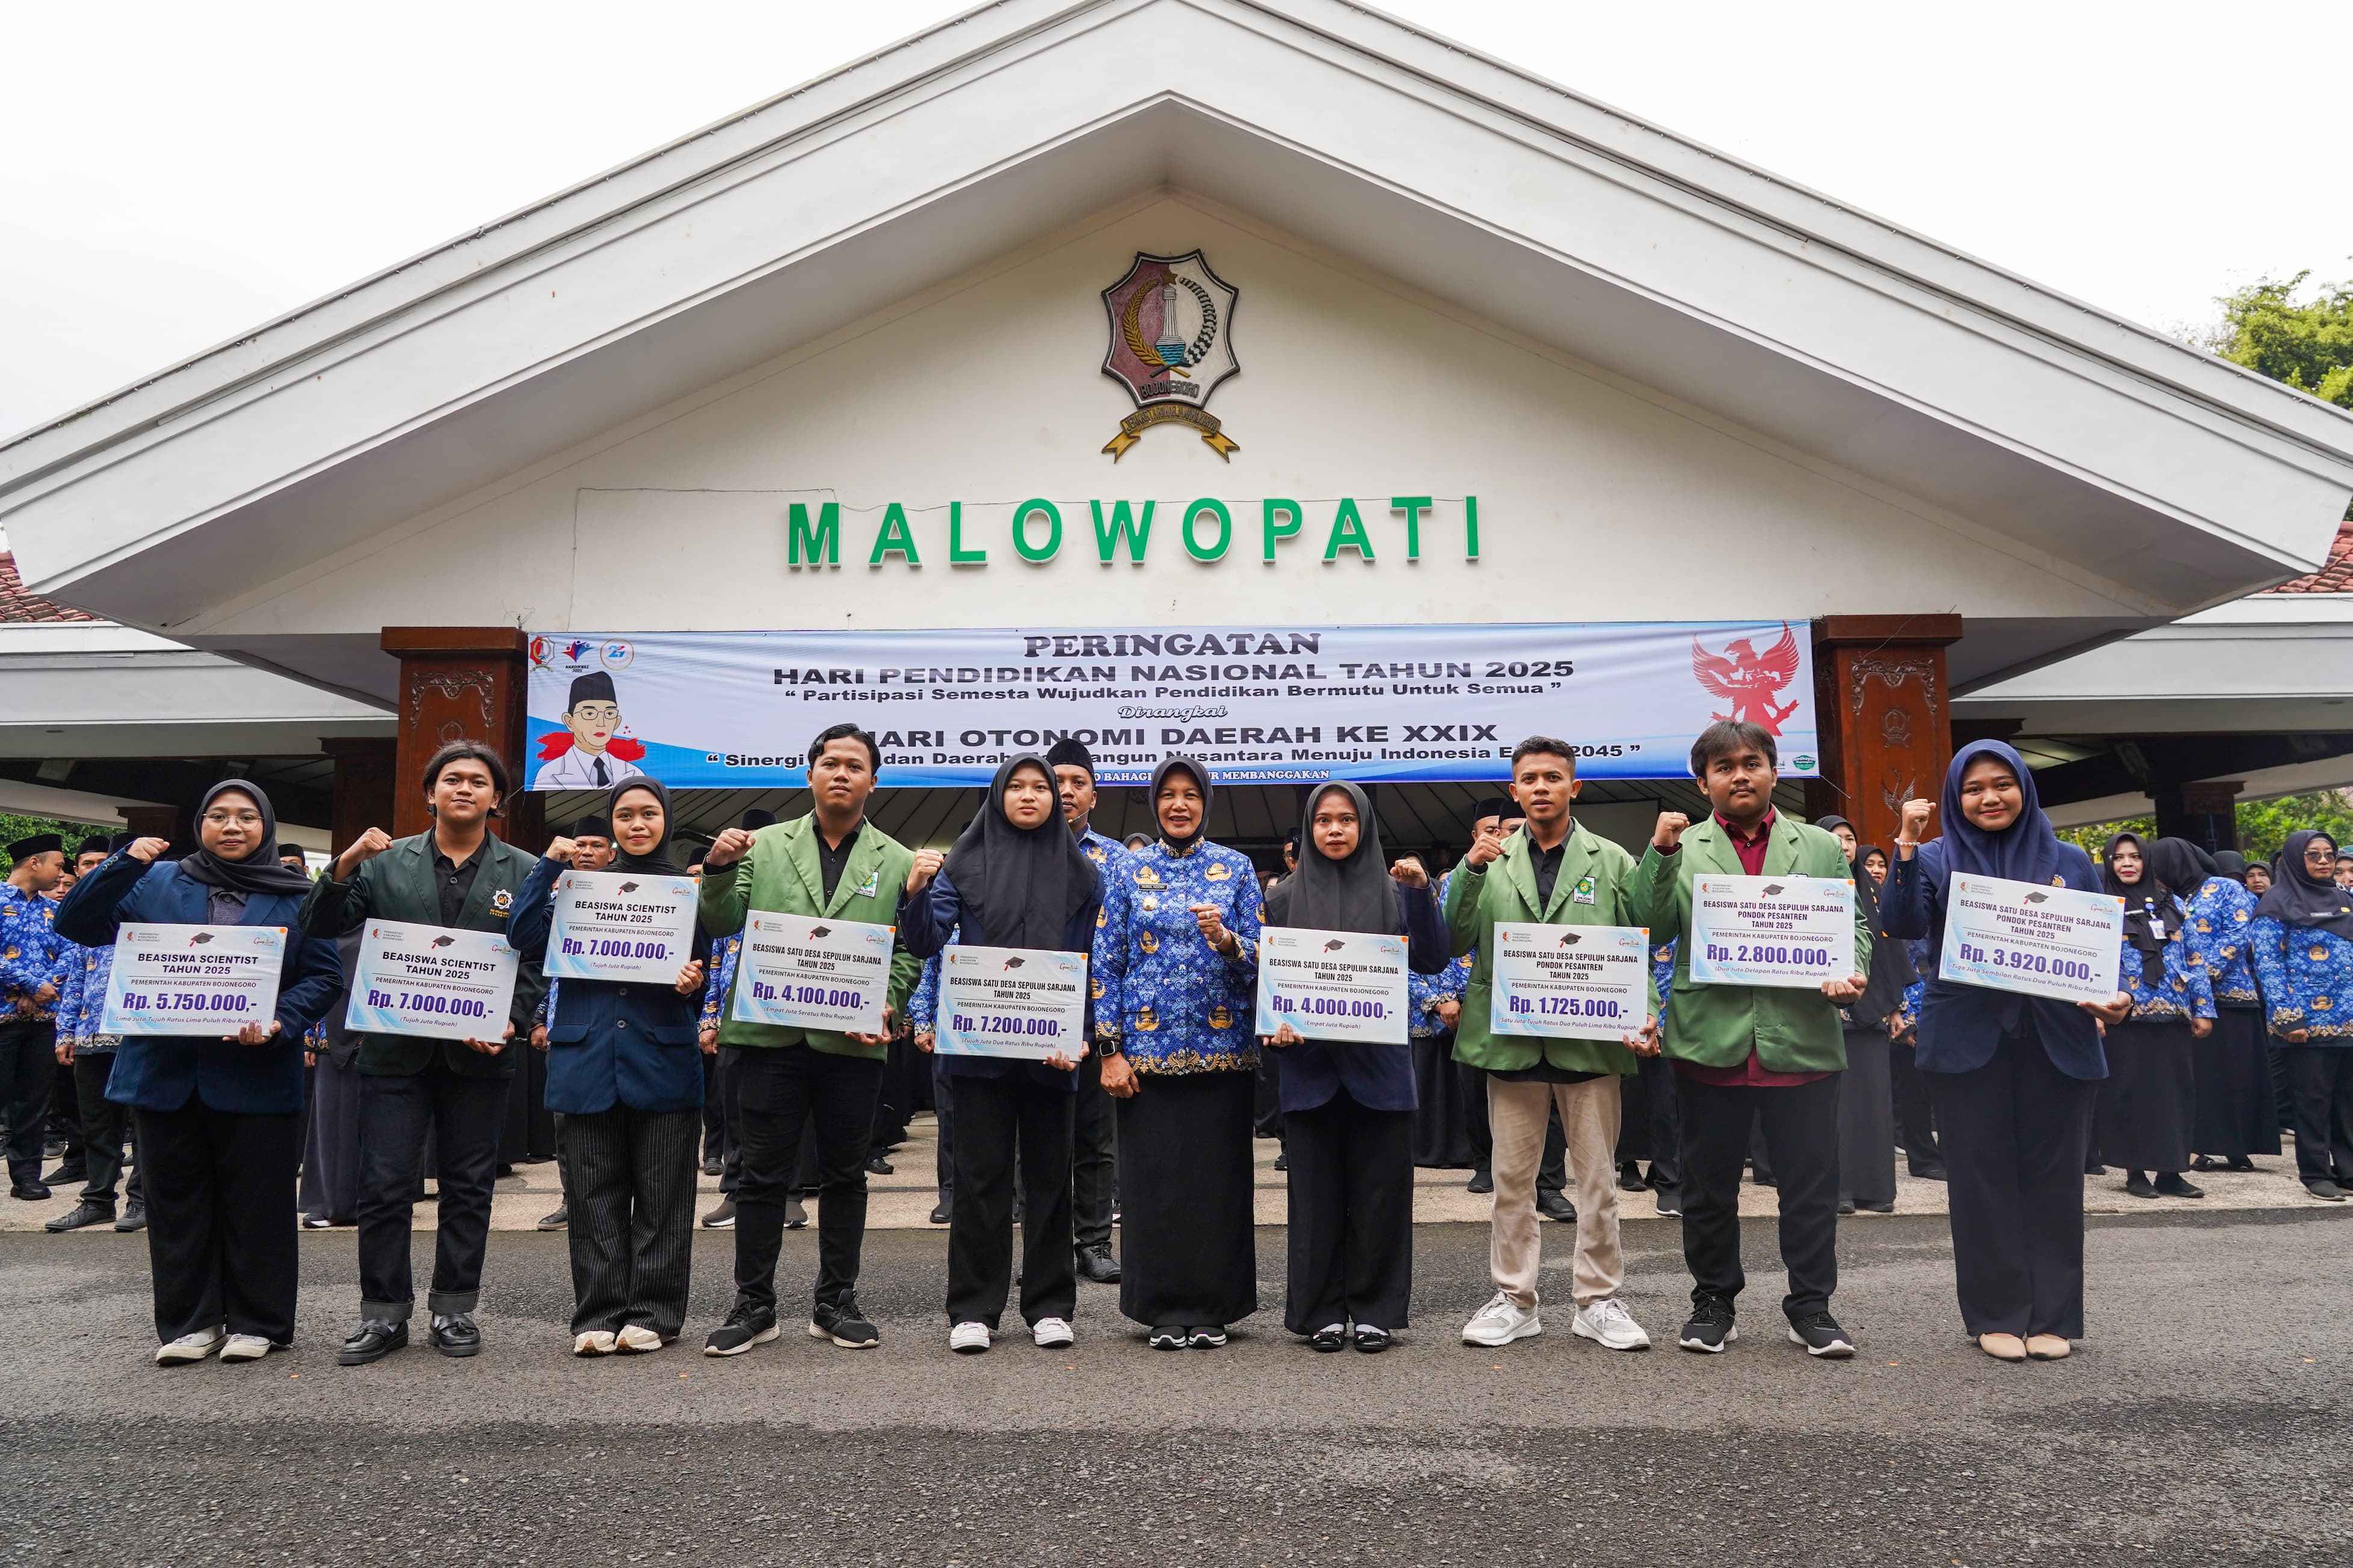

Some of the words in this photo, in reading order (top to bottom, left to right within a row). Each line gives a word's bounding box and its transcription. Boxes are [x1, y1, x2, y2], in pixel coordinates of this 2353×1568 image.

[788, 496, 1481, 568] MALOWOPATI
[1023, 633, 1322, 657] PERINGATAN
[774, 668, 865, 684] HARI
[880, 666, 1116, 684] PENDIDIKAN
[1132, 664, 1327, 681] NASIONAL
[1339, 662, 1472, 679] TAHUN
[1485, 660, 1574, 678] 2025
[803, 689, 924, 703] Partisipasi
[931, 687, 1030, 701] Semesta
[1037, 687, 1147, 702] Wujudkan
[1155, 686, 1279, 698] Pendidikan
[1288, 684, 1384, 696] Bermutu
[1393, 683, 1460, 695] Untuk
[1467, 683, 1543, 694] Semua
[1117, 704, 1229, 722] Dirangkai
[960, 728, 1144, 747] OTONOMI
[1161, 727, 1321, 745] DAERAH
[1337, 725, 1389, 743] KE
[1402, 724, 1499, 742] XXIX
[725, 754, 804, 768] Sinergi
[883, 753, 924, 764] dan
[933, 752, 1011, 764] Daerah
[1091, 752, 1157, 765] angun
[1292, 748, 1372, 762] Menuju
[1381, 746, 1490, 759] Indonesia
[1574, 745, 1623, 757] 2045
[1103, 772, 1152, 781] BAHAGI
[1223, 769, 1330, 781] MEMBANGGAKAN
[575, 900, 623, 911] BEASISWA
[626, 903, 677, 914] SCIENTIST
[1738, 911, 1766, 919] PONDOK
[1767, 912, 1807, 921] PESANTREN
[1778, 903, 1809, 911] SEPULUH
[1811, 905, 1843, 913] SARJANA
[1960, 899, 1997, 912] BEASISWA
[1999, 905, 2017, 915] SATU
[2019, 908, 2038, 918] DESA
[2040, 912, 2074, 924] SEPULUH
[2076, 917, 2111, 930] SARJANA
[595, 912, 628, 922] TAHUN
[630, 914, 653, 923] 2025
[1751, 920, 1774, 929] TAHUN
[1996, 914, 2026, 926] PONDOK
[2028, 919, 2071, 933] PESANTREN
[2011, 926, 2035, 936] TAHUN
[2037, 930, 2055, 939] 2025
[562, 938, 585, 956] Rp.
[589, 939, 674, 961] 7.000.000,-
[1967, 931, 2009, 943] PEMERINTAH
[2010, 938, 2050, 950] KABUPATEN
[2050, 945, 2098, 958] BOJONEGORO
[138, 953, 196, 963] BEASISWA
[199, 955, 259, 965] SCIENTIST
[382, 951, 437, 965] BEASISWA
[440, 958, 496, 972] SCIENTIST
[753, 943, 785, 955] BEASISWA
[786, 947, 803, 956] SATU
[804, 949, 821, 958] DESA
[822, 951, 851, 962] SEPULUH
[852, 955, 881, 965] SARJANA
[1503, 950, 1537, 958] BEASISWA
[1538, 952, 1555, 960] SATU
[1556, 952, 1573, 961] DESA
[1575, 953, 1605, 962] SEPULUH
[1606, 955, 1638, 963] SARJANA
[1707, 944, 1733, 962] Rp.
[1737, 945, 1838, 968] 2.800.000,-
[1960, 943, 1988, 964] Rp.
[1993, 948, 2101, 983] 3.920.000,-
[162, 965, 202, 974] TAHUN
[204, 966, 231, 974] 2025
[406, 965, 442, 977] TAHUN
[445, 969, 470, 980] 2025
[797, 959, 818, 969] TAHUN
[819, 961, 835, 971] 2025
[1269, 958, 1302, 968] BEASISWA
[1303, 961, 1319, 970] SATU
[1321, 962, 1337, 971] DESA
[1339, 963, 1368, 973] SEPULUH
[1369, 965, 1399, 975] SARJANA
[1537, 961, 1563, 970] PONDOK
[1565, 962, 1603, 971] PESANTREN
[758, 968, 795, 978] PEMERINTAH
[796, 973, 830, 982] KABUPATEN
[830, 976, 870, 986] BOJONEGORO
[950, 977, 982, 986] BEASISWA
[983, 979, 999, 988] SATU
[1000, 980, 1016, 989] DESA
[1017, 981, 1046, 991] SEPULUH
[1047, 983, 1076, 992] SARJANA
[1315, 971, 1335, 981] TAHUN
[1337, 973, 1352, 982] 2025
[1573, 972, 1589, 980] 2025
[375, 976, 415, 986] PEMERINTAH
[416, 981, 452, 990] KABUPATEN
[452, 985, 493, 995] BOJONEGORO
[1349, 988, 1389, 996] BOJONEGORO
[1586, 986, 1627, 994] BOJONEGORO
[122, 992, 151, 1011] Rp.
[156, 993, 258, 1013] 5.750.000,-
[367, 989, 394, 1009] Rp.
[399, 992, 494, 1019] 7.000.000,-
[752, 981, 777, 1001] Rp.
[781, 985, 870, 1011] 4.100.000,-
[994, 990, 1014, 999] TAHUN
[1015, 991, 1031, 1000] 2025
[1272, 995, 1297, 1013] Rp.
[1300, 997, 1393, 1021] 4.000.000,-
[1510, 995, 1535, 1015] Rp.
[1538, 997, 1629, 1020] 1.725.000,-
[952, 1014, 976, 1033] Rp.
[981, 1016, 1067, 1038] 7.200.000,-
